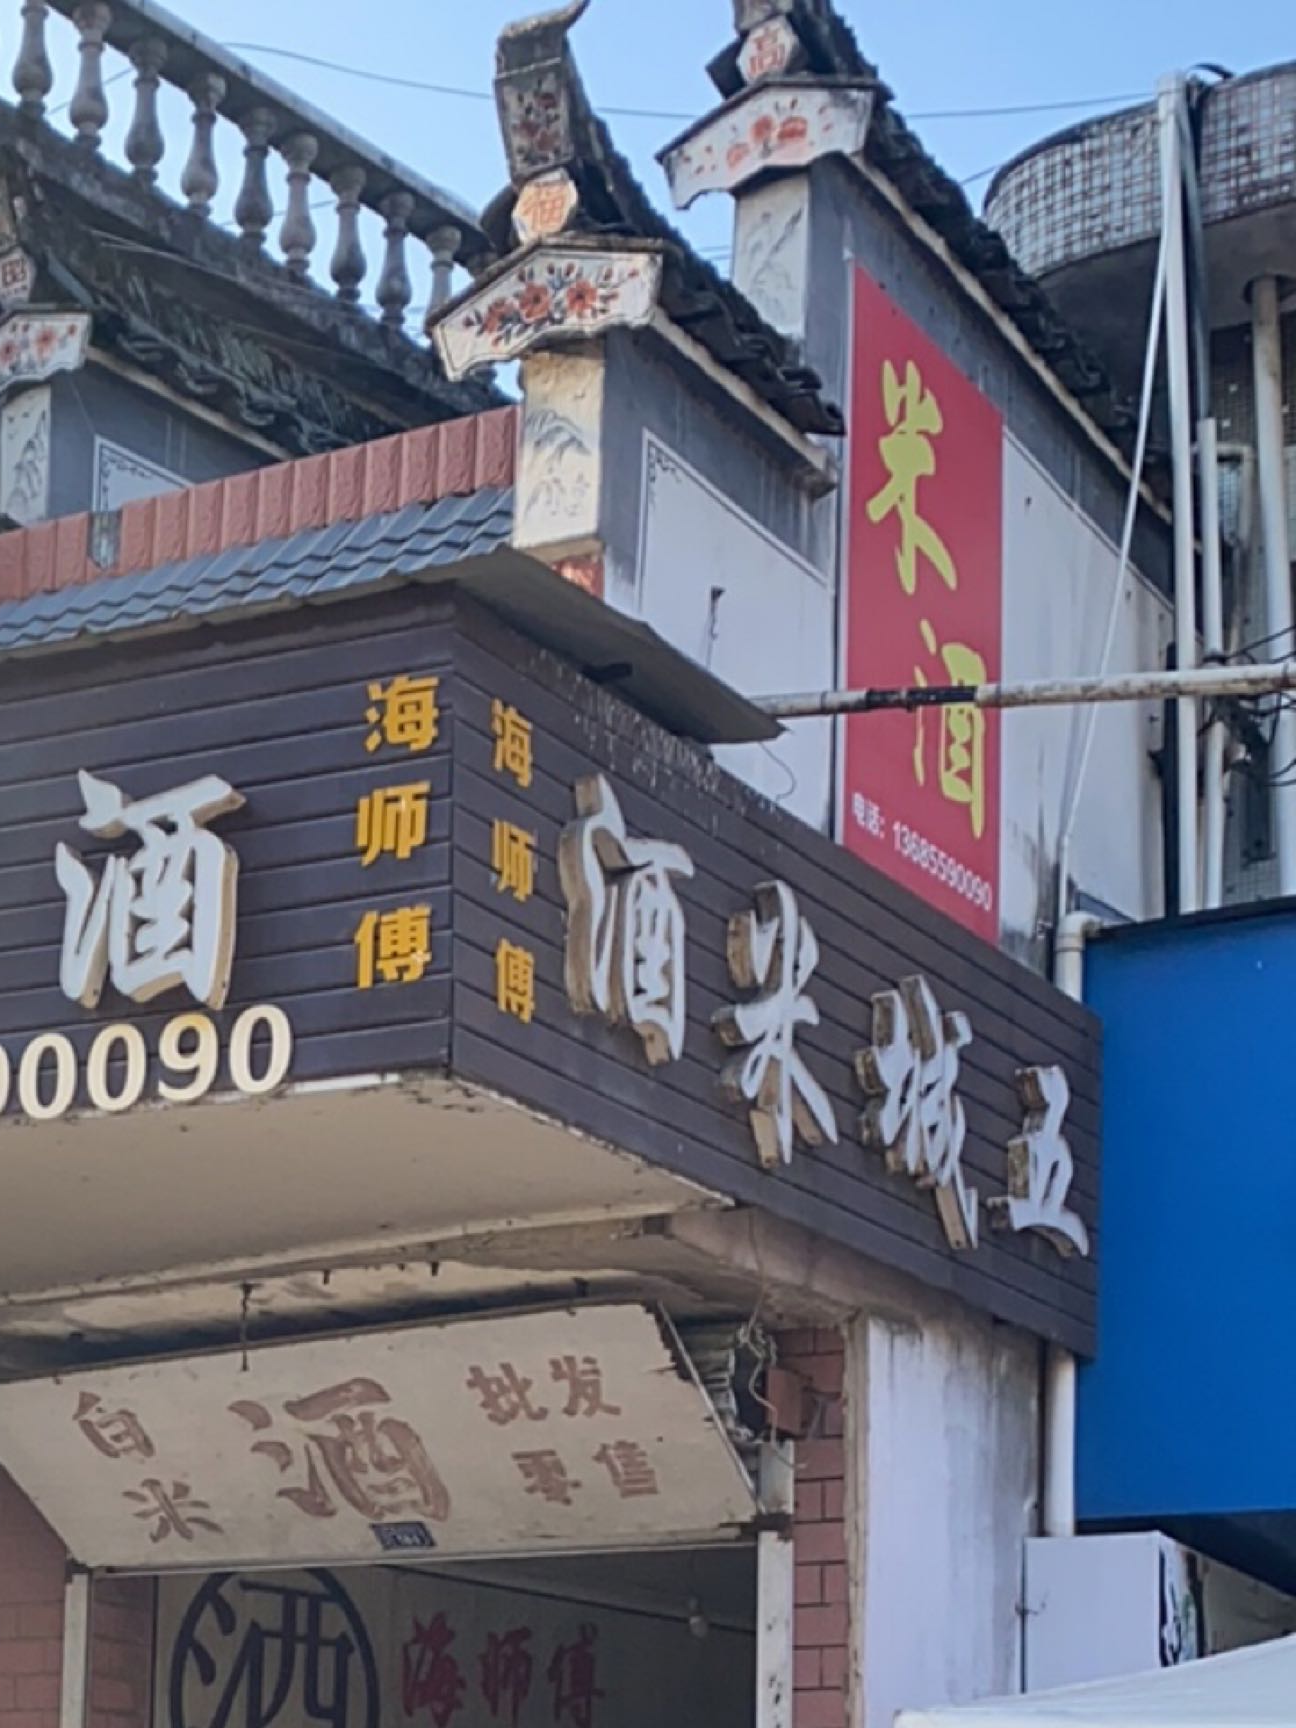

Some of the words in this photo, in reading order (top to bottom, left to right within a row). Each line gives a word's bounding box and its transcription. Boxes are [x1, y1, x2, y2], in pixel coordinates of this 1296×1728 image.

[354, 674, 440, 990] 海师傅
[489, 698, 536, 1024] 海师傅
[466, 1354, 622, 1426] 批发
